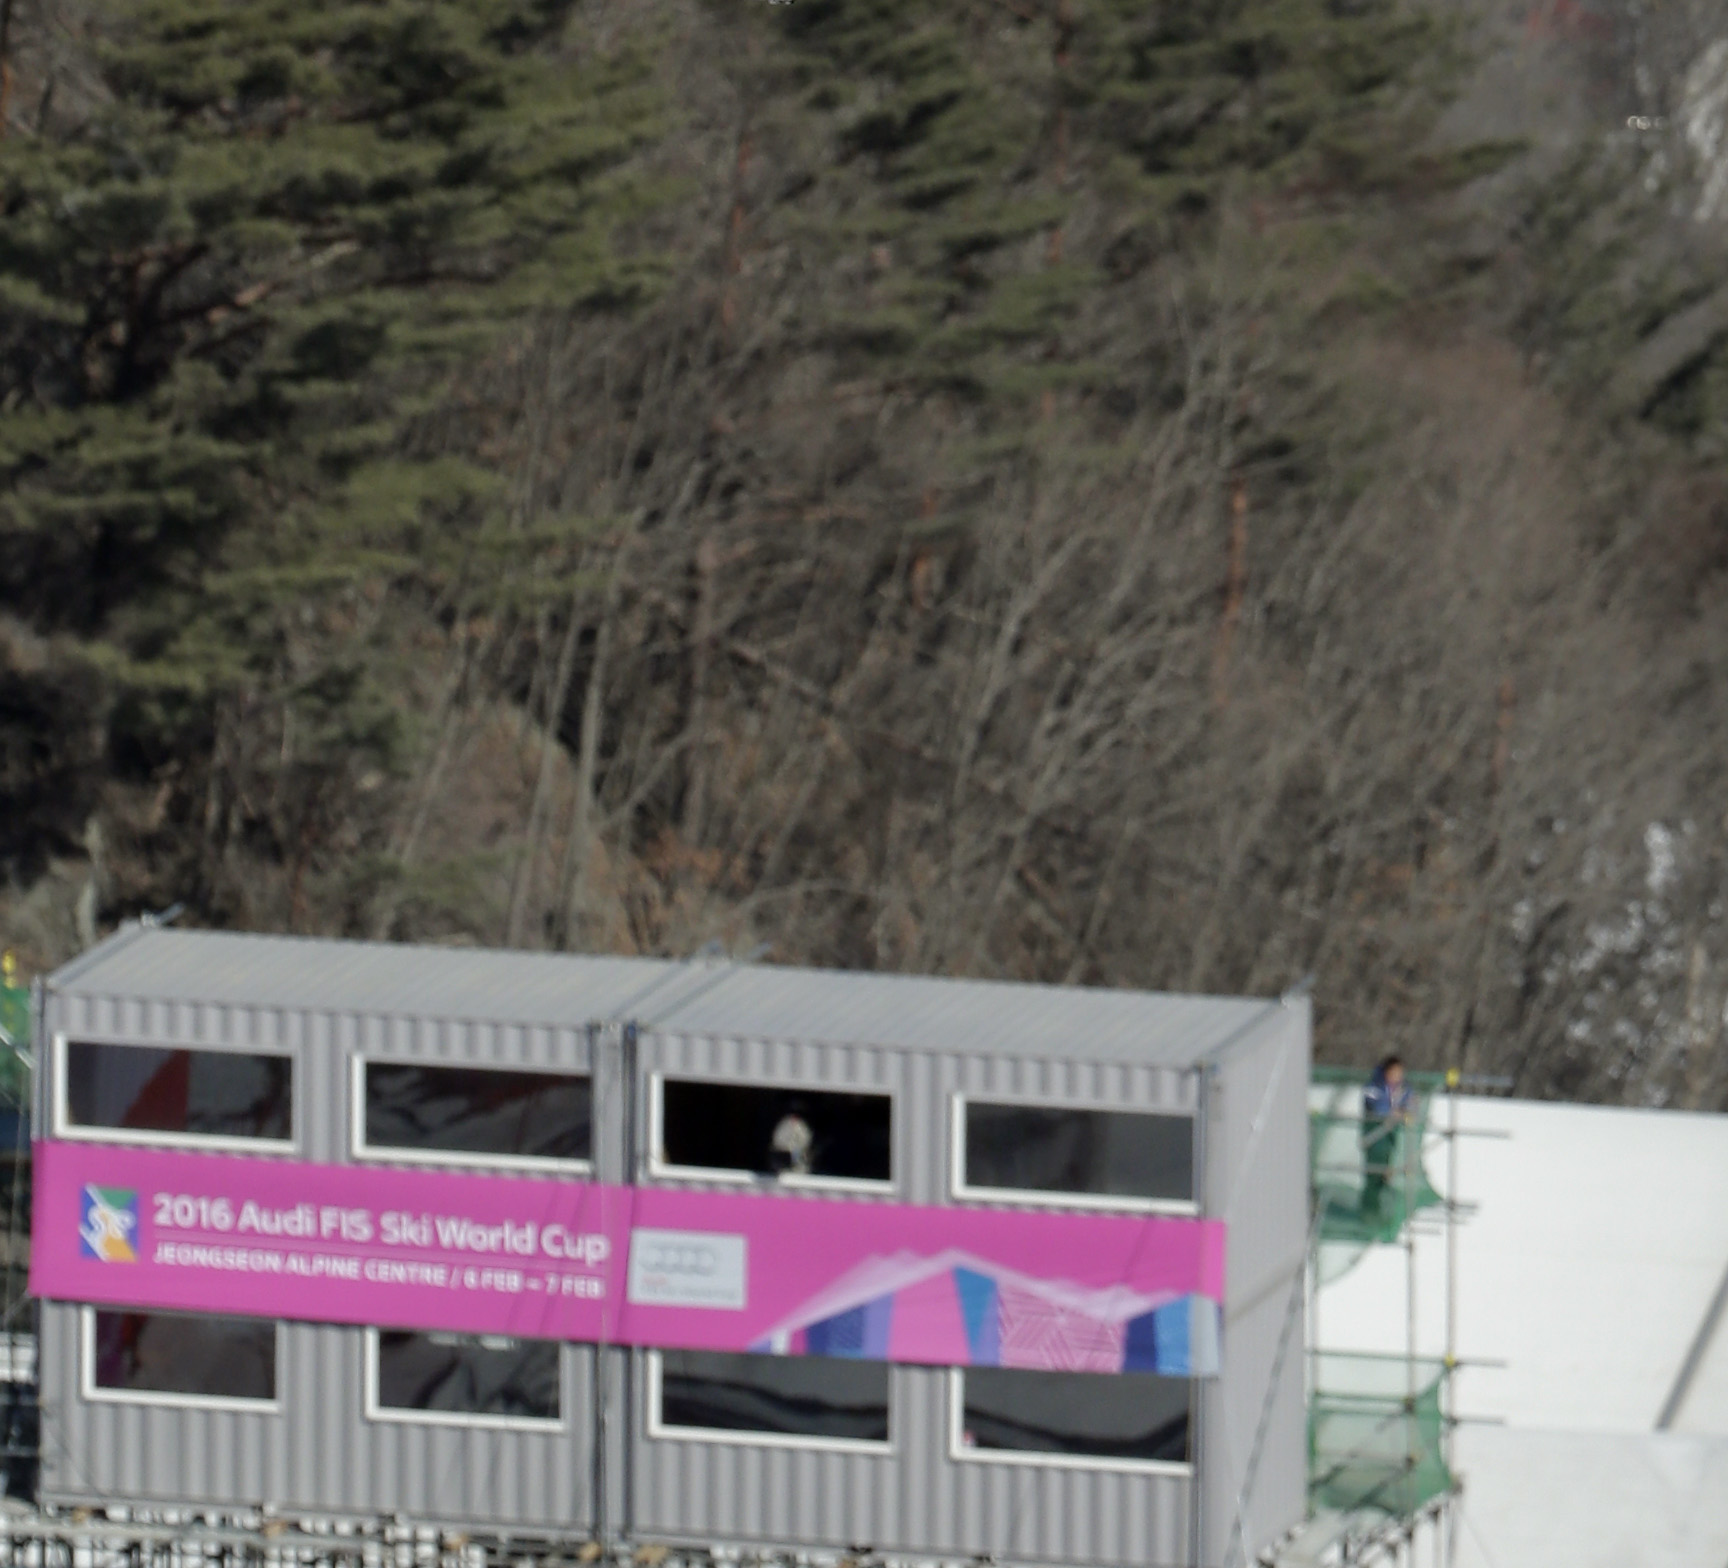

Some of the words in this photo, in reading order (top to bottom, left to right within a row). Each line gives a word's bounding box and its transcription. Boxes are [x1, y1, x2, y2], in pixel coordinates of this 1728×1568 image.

[153, 1192, 234, 1231] 2016
[237, 1198, 316, 1237] Audi
[319, 1205, 374, 1242] FIS
[379, 1210, 433, 1247] Ski
[435, 1214, 539, 1255] World
[540, 1224, 610, 1268] Cup
[153, 1241, 281, 1273] JEONGSEON
[284, 1252, 361, 1279] ALPINE
[364, 1257, 446, 1288] CENTRE
[481, 1268, 522, 1293] FEB
[546, 1272, 559, 1295] 7
[562, 1274, 605, 1299] FEB
